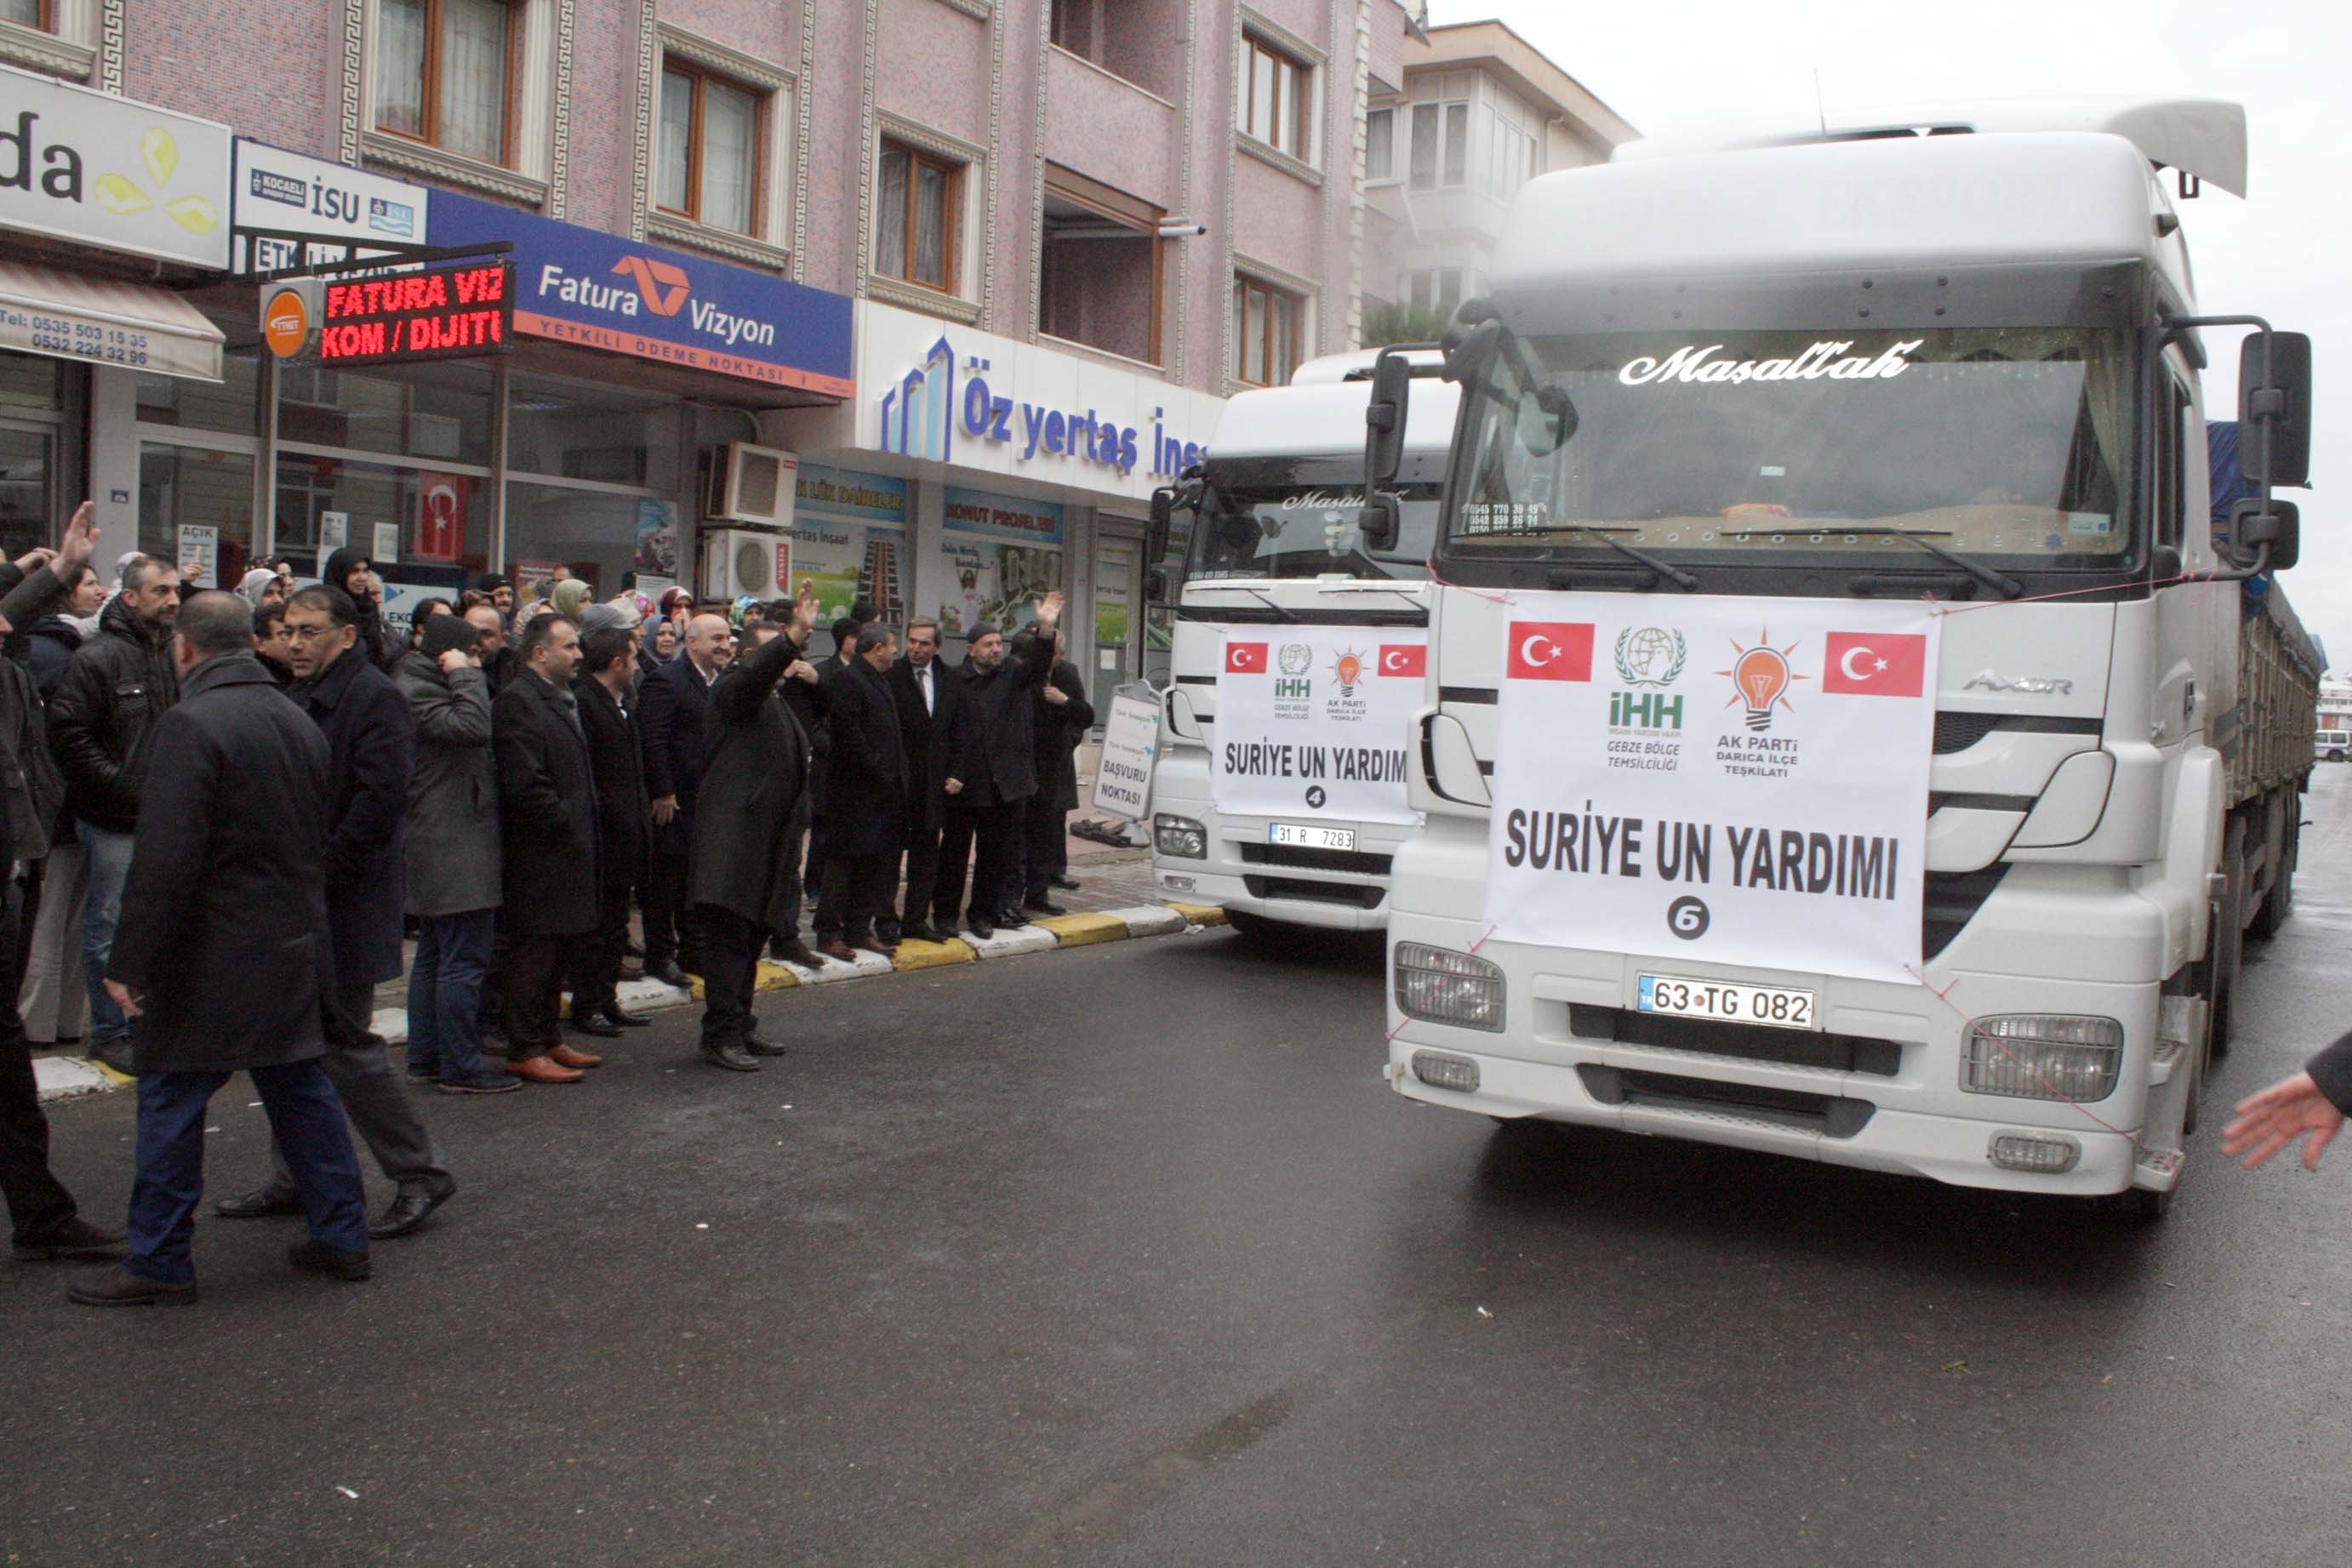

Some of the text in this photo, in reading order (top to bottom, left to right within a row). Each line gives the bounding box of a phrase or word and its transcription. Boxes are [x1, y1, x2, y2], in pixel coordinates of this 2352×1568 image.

[311, 176, 359, 223] İSU
[328, 275, 447, 317] FATURA
[539, 265, 638, 316] Fatura
[0, 310, 27, 327] Tel:
[32, 316, 70, 334] 0535
[76, 323, 102, 340] 503
[109, 330, 125, 345] 15
[321, 322, 385, 358] KOM
[690, 299, 775, 346] Vizyon
[32, 334, 70, 351] 0532
[539, 319, 782, 382] YETKİLİ ÖDEME NOKTASI
[1618, 339, 1925, 385] Maşallah
[964, 356, 1013, 442] Öz
[1023, 403, 1138, 476] yertaş
[182, 526, 214, 539] AÇIK
[1225, 736, 1293, 777] SURİYE
[1299, 745, 1326, 779] UN
[1607, 740, 1681, 755] GEBZE BÖLGE
[1716, 751, 1797, 766] DARICA İLÇE
[1717, 734, 1742, 749] AK
[1103, 759, 1147, 783] BAŞVURU
[1724, 764, 1788, 778] TEŞKİLATI
[1101, 784, 1141, 807] NOKTASI
[1307, 788, 1323, 807] 4
[1280, 827, 1352, 847] 31 R 7283
[1504, 800, 1899, 901] SURİYE UN YARDIMI
[1673, 903, 1704, 933] 6
[1655, 983, 1808, 1023] 63 TG 082
